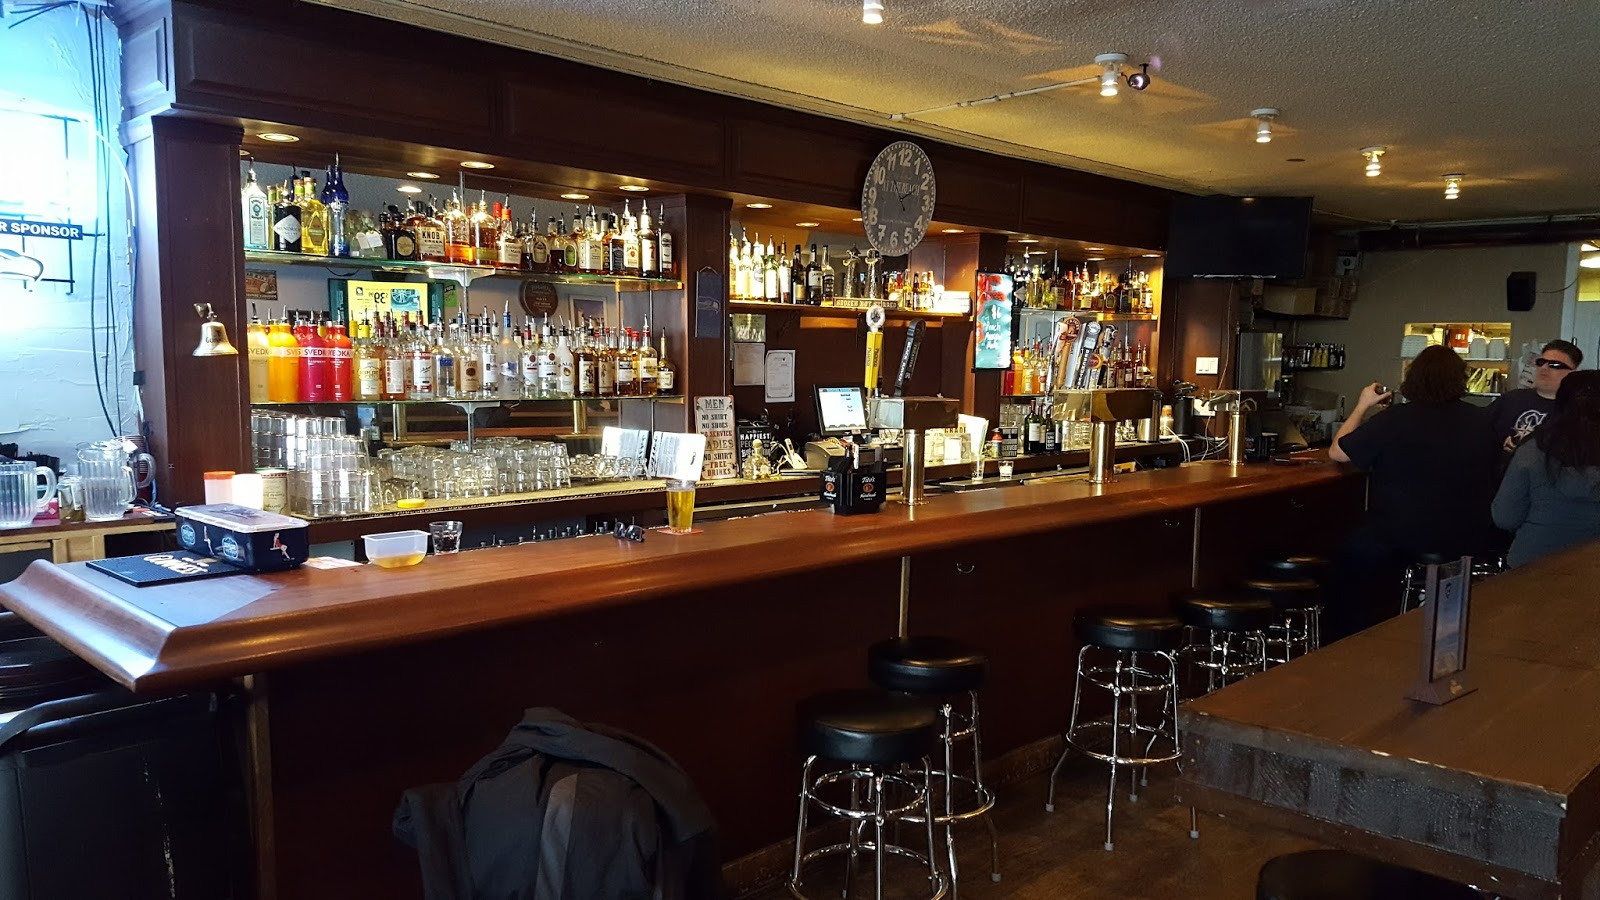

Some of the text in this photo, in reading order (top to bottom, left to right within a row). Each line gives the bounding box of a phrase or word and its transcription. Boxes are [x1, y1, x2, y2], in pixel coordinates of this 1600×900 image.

[886, 152, 897, 171] 11
[898, 148, 912, 167] 12
[873, 165, 886, 185] 10
[914, 158, 921, 175] 1
[921, 173, 930, 190] 2
[868, 187, 877, 204] 9
[922, 195, 930, 212] 3
[868, 207, 878, 225] 8
[914, 215, 922, 232] 4
[11, 222, 79, 237] SPONSOR
[422, 231, 440, 240] KNOB
[878, 225, 886, 241] 7
[904, 227, 913, 244] 5
[890, 231, 898, 247] 6
[705, 399, 724, 408] MEN
[706, 439, 734, 449] ADIES
[740, 433, 770, 441] HAPPIEST
[714, 452, 732, 460] SHIRT
[707, 469, 731, 477] DRINKS
